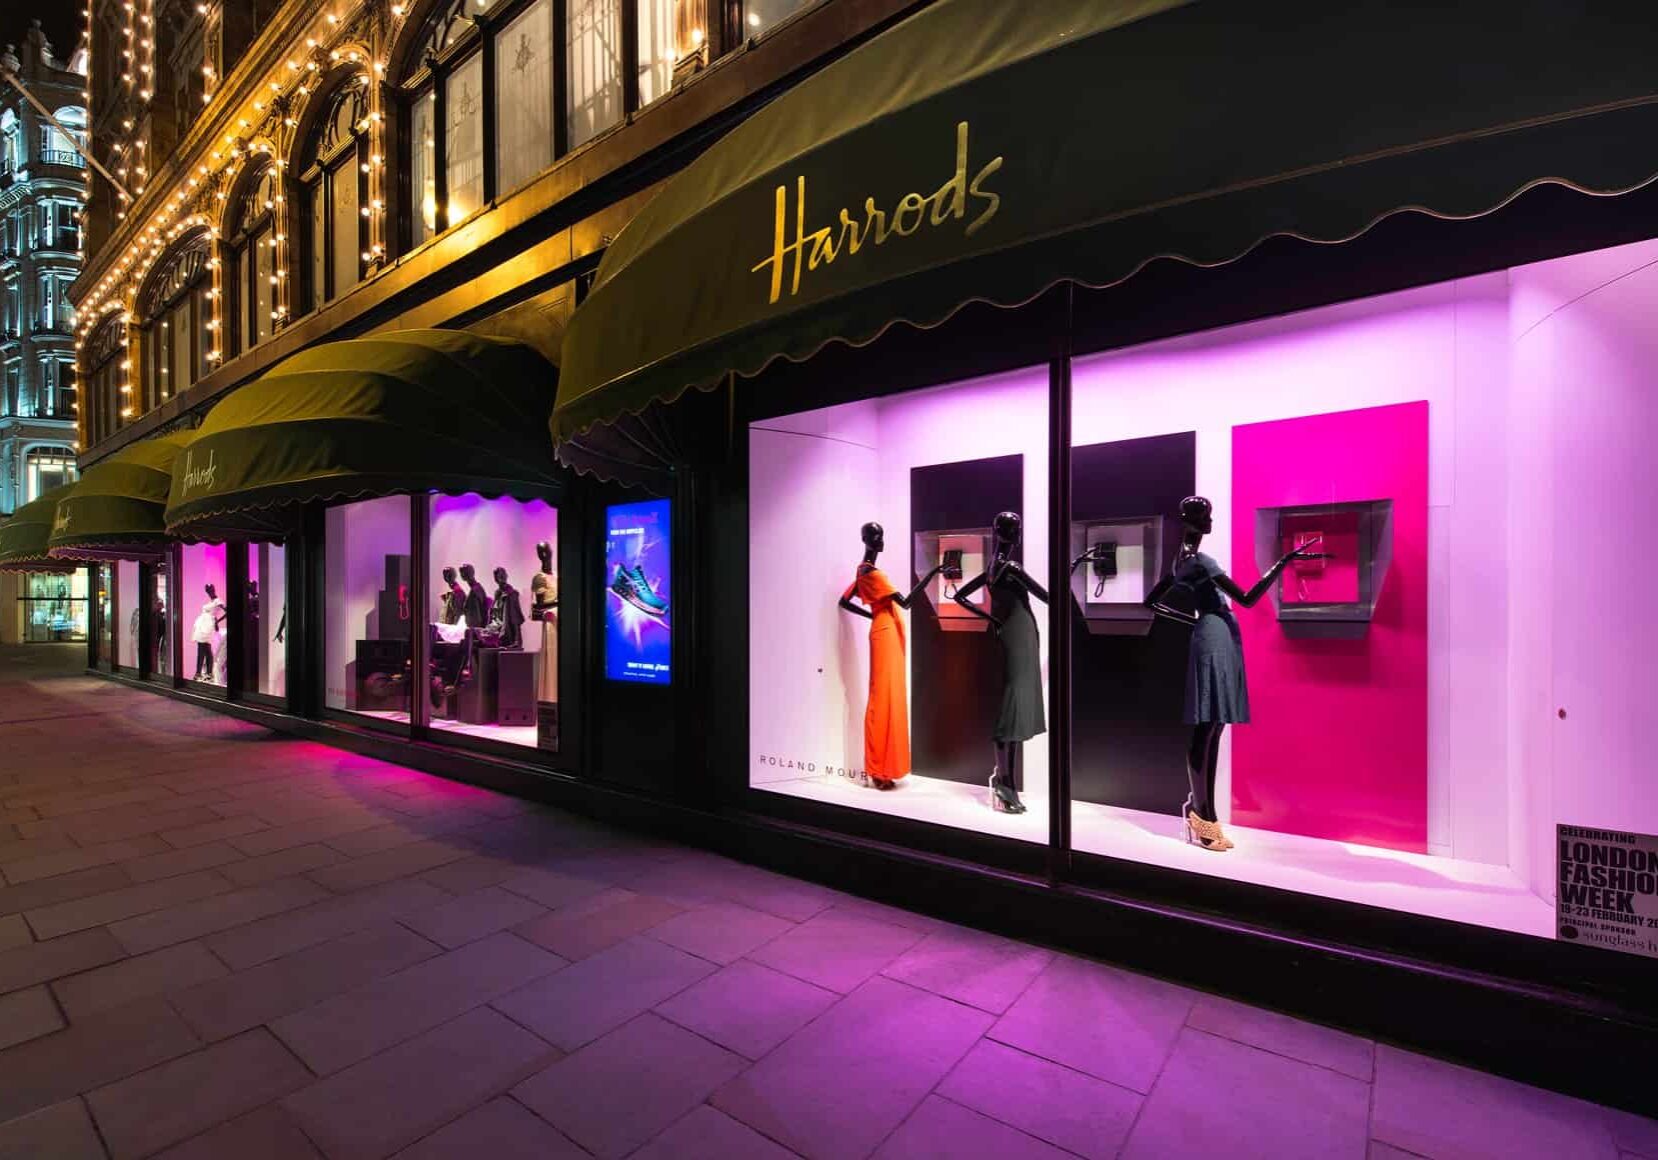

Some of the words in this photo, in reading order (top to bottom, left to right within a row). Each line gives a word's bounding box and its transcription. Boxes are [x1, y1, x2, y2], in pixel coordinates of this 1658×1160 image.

[751, 121, 1003, 304] Harrods
[181, 449, 217, 497] Harrods
[759, 755, 816, 772] ROLAND
[825, 765, 868, 781] MOUR
[1560, 826, 1635, 844] CELEBRATING
[1561, 862, 1658, 896] FASHIO
[1561, 882, 1635, 914] WEEK
[1561, 903, 1590, 917] 19-23
[1591, 909, 1644, 927] FEBRUARY
